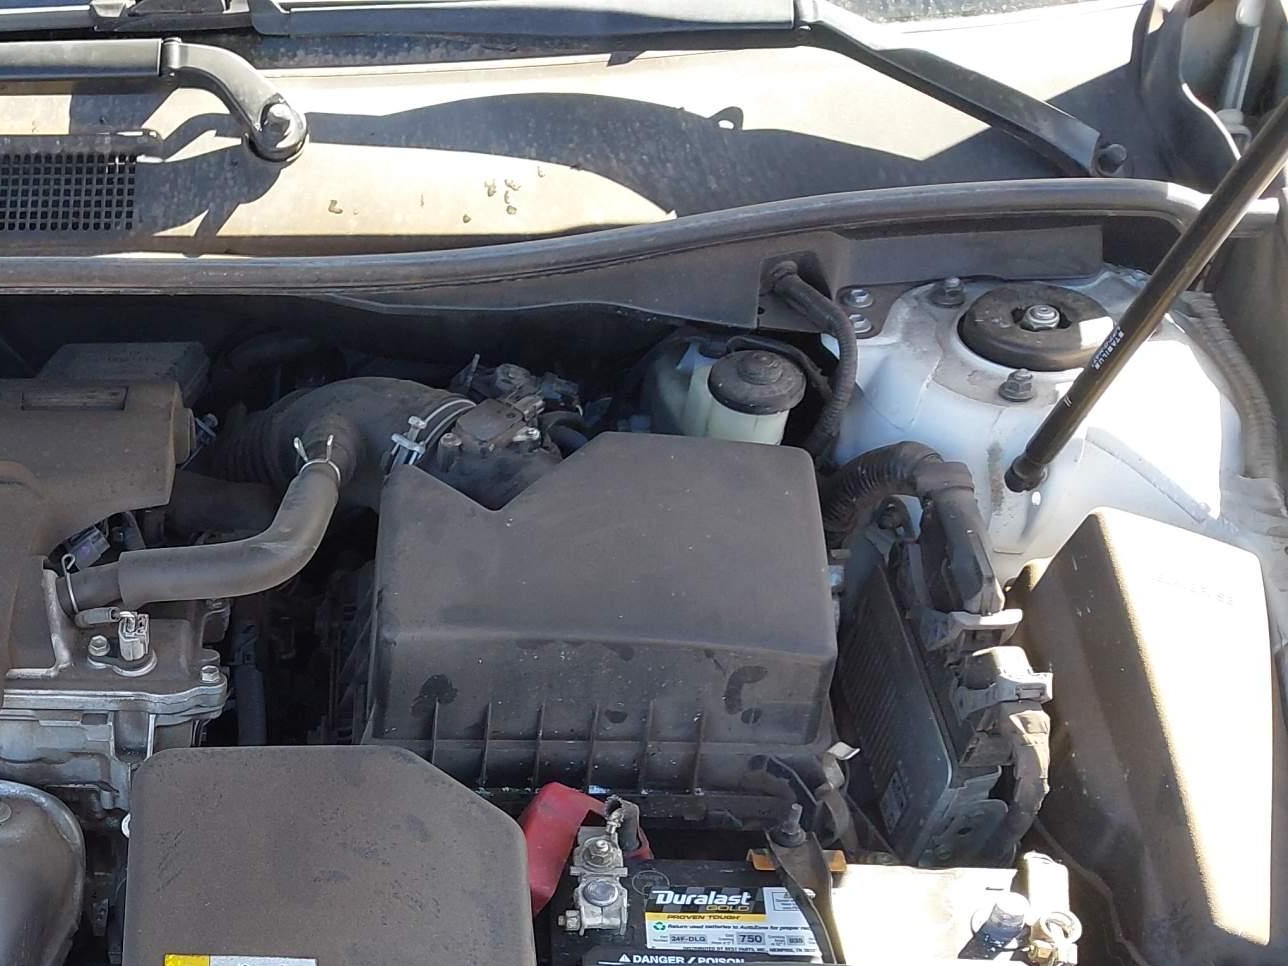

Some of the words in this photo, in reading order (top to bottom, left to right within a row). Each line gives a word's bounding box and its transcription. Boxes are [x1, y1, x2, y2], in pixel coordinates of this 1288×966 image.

[652, 890, 751, 905] Duralast
[739, 935, 762, 943] 750
[633, 954, 684, 964] DANGER
